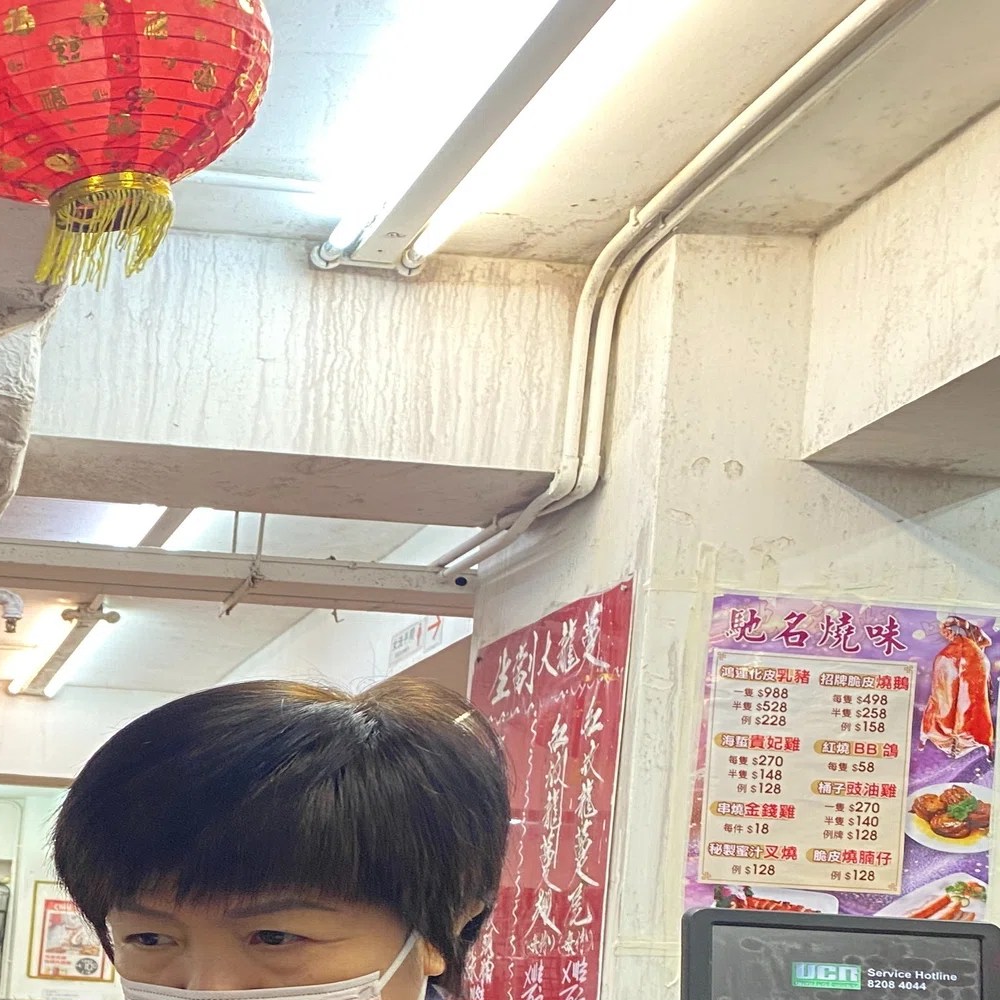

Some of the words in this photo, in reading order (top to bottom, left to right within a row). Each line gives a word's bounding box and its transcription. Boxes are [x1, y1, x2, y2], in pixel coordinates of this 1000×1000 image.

[725, 608, 908, 655] 馳名燒味
[820, 673, 909, 690] 招牌脆皮燒鵝
[733, 688, 753, 698] 一隻
[757, 688, 789, 699] $988
[833, 694, 852, 704] 每隻
[856, 694, 888, 705] $498
[732, 701, 753, 711] 半隻
[756, 701, 788, 712] $528
[831, 708, 852, 718] 半隻
[856, 708, 887, 719] $258
[741, 716, 751, 725] 例
[755, 715, 787, 726] $228
[840, 722, 851, 732] 例
[855, 721, 885, 732] $158
[721, 734, 800, 752] 海蜇貴妃雞
[822, 741, 850, 755] 紅燒
[854, 743, 877, 755] BB
[882, 743, 899, 758] 鴿
[729, 756, 748, 766] 每隻
[752, 755, 784, 767] $270
[827, 762, 847, 772] 每隻
[852, 762, 875, 773] $58
[728, 769, 748, 779] 半隻
[752, 769, 782, 781] $148
[737, 784, 747, 793] 例
[751, 782, 781, 794] $128
[818, 781, 897, 798] 桶子豉油雞
[717, 802, 796, 819] 串燒金錢雞
[824, 803, 845, 812] 一隻
[849, 802, 880, 813] $270
[824, 816, 845, 826] 半隻
[848, 815, 879, 827] $140
[723, 823, 743, 833] 每件
[747, 822, 769, 834] $18
[823, 830, 844, 840] 例牌
[847, 829, 878, 841] $128
[813, 850, 892, 866] 脆皮燒腩仔
[731, 865, 742, 875] 例
[745, 864, 775, 875] $128
[830, 871, 841, 880] 例
[845, 869, 875, 881] $128
[867, 968, 912, 978] Service
[915, 971, 958, 981] Hotline
[867, 980, 895, 989] 8208
[898, 981, 927, 991] 4044
